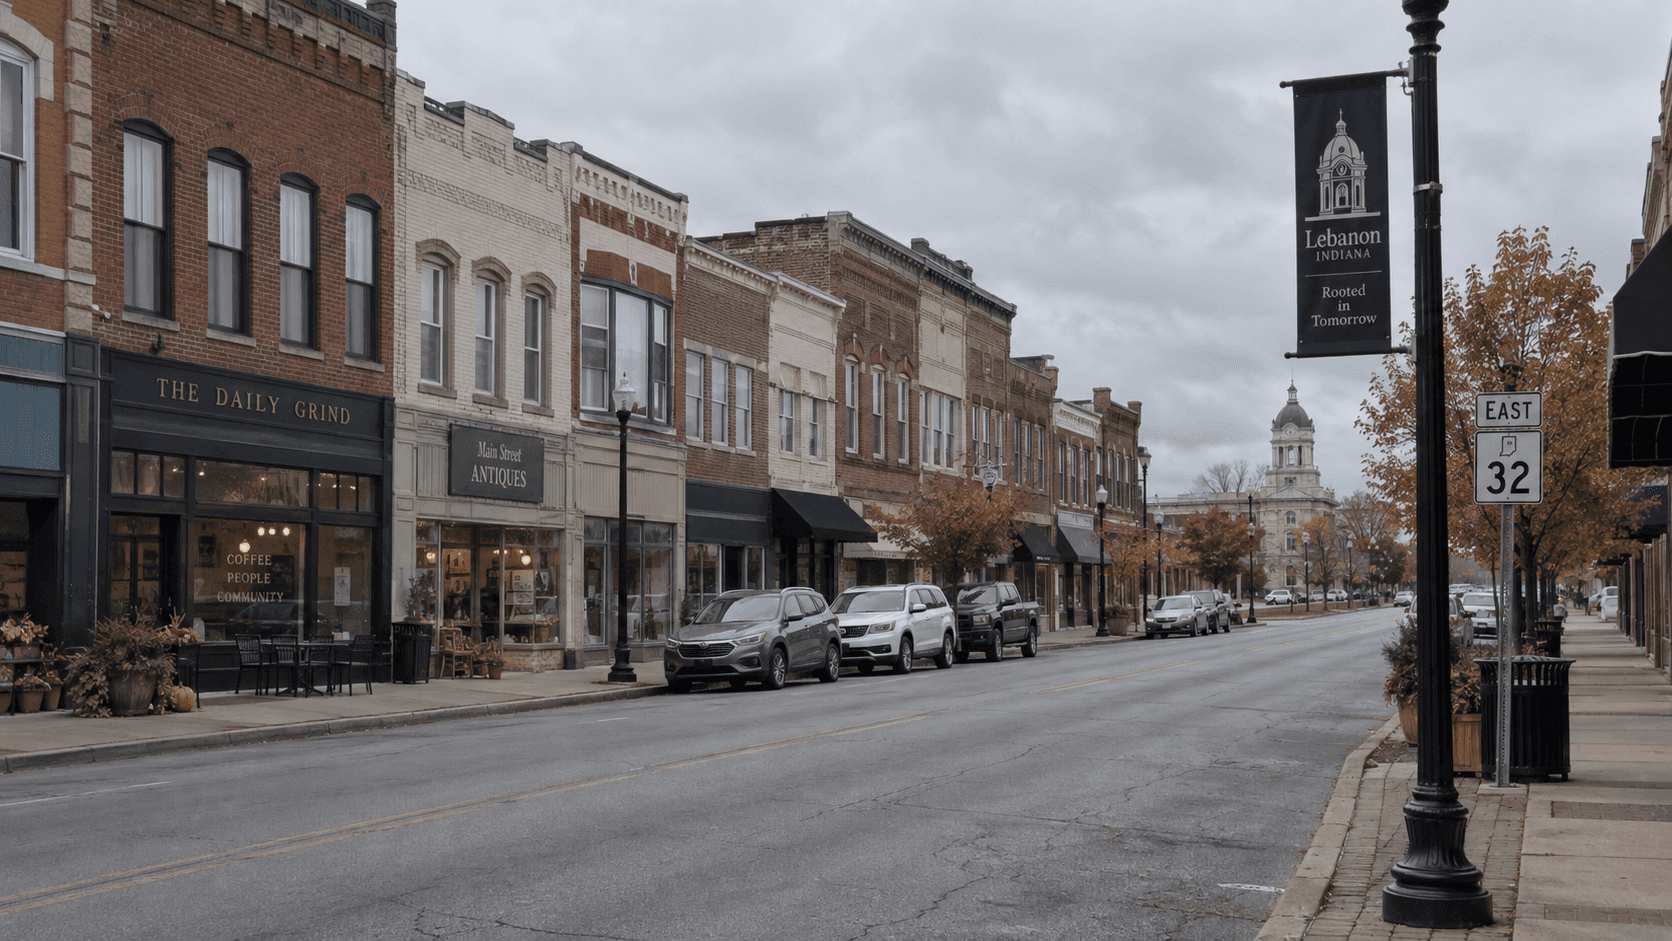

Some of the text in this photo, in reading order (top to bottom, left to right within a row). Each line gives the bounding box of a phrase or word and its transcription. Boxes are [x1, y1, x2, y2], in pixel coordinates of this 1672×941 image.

[1305, 227, 1382, 249] Lebanon
[1317, 249, 1370, 261] INDIANA
[1323, 284, 1365, 298] Rooted
[1338, 300, 1351, 311] in
[1311, 315, 1376, 326] Tomorrow
[156, 378, 350, 424] THE DAILY GRIND
[1486, 401, 1532, 420] EAST
[477, 441, 521, 462] Main Street
[472, 465, 526, 488] ANTIQUES
[1487, 461, 1529, 494] 32
[226, 554, 271, 565] COFFEE
[227, 573, 270, 584] PEOPLE
[217, 591, 283, 602] COMMUNITY
